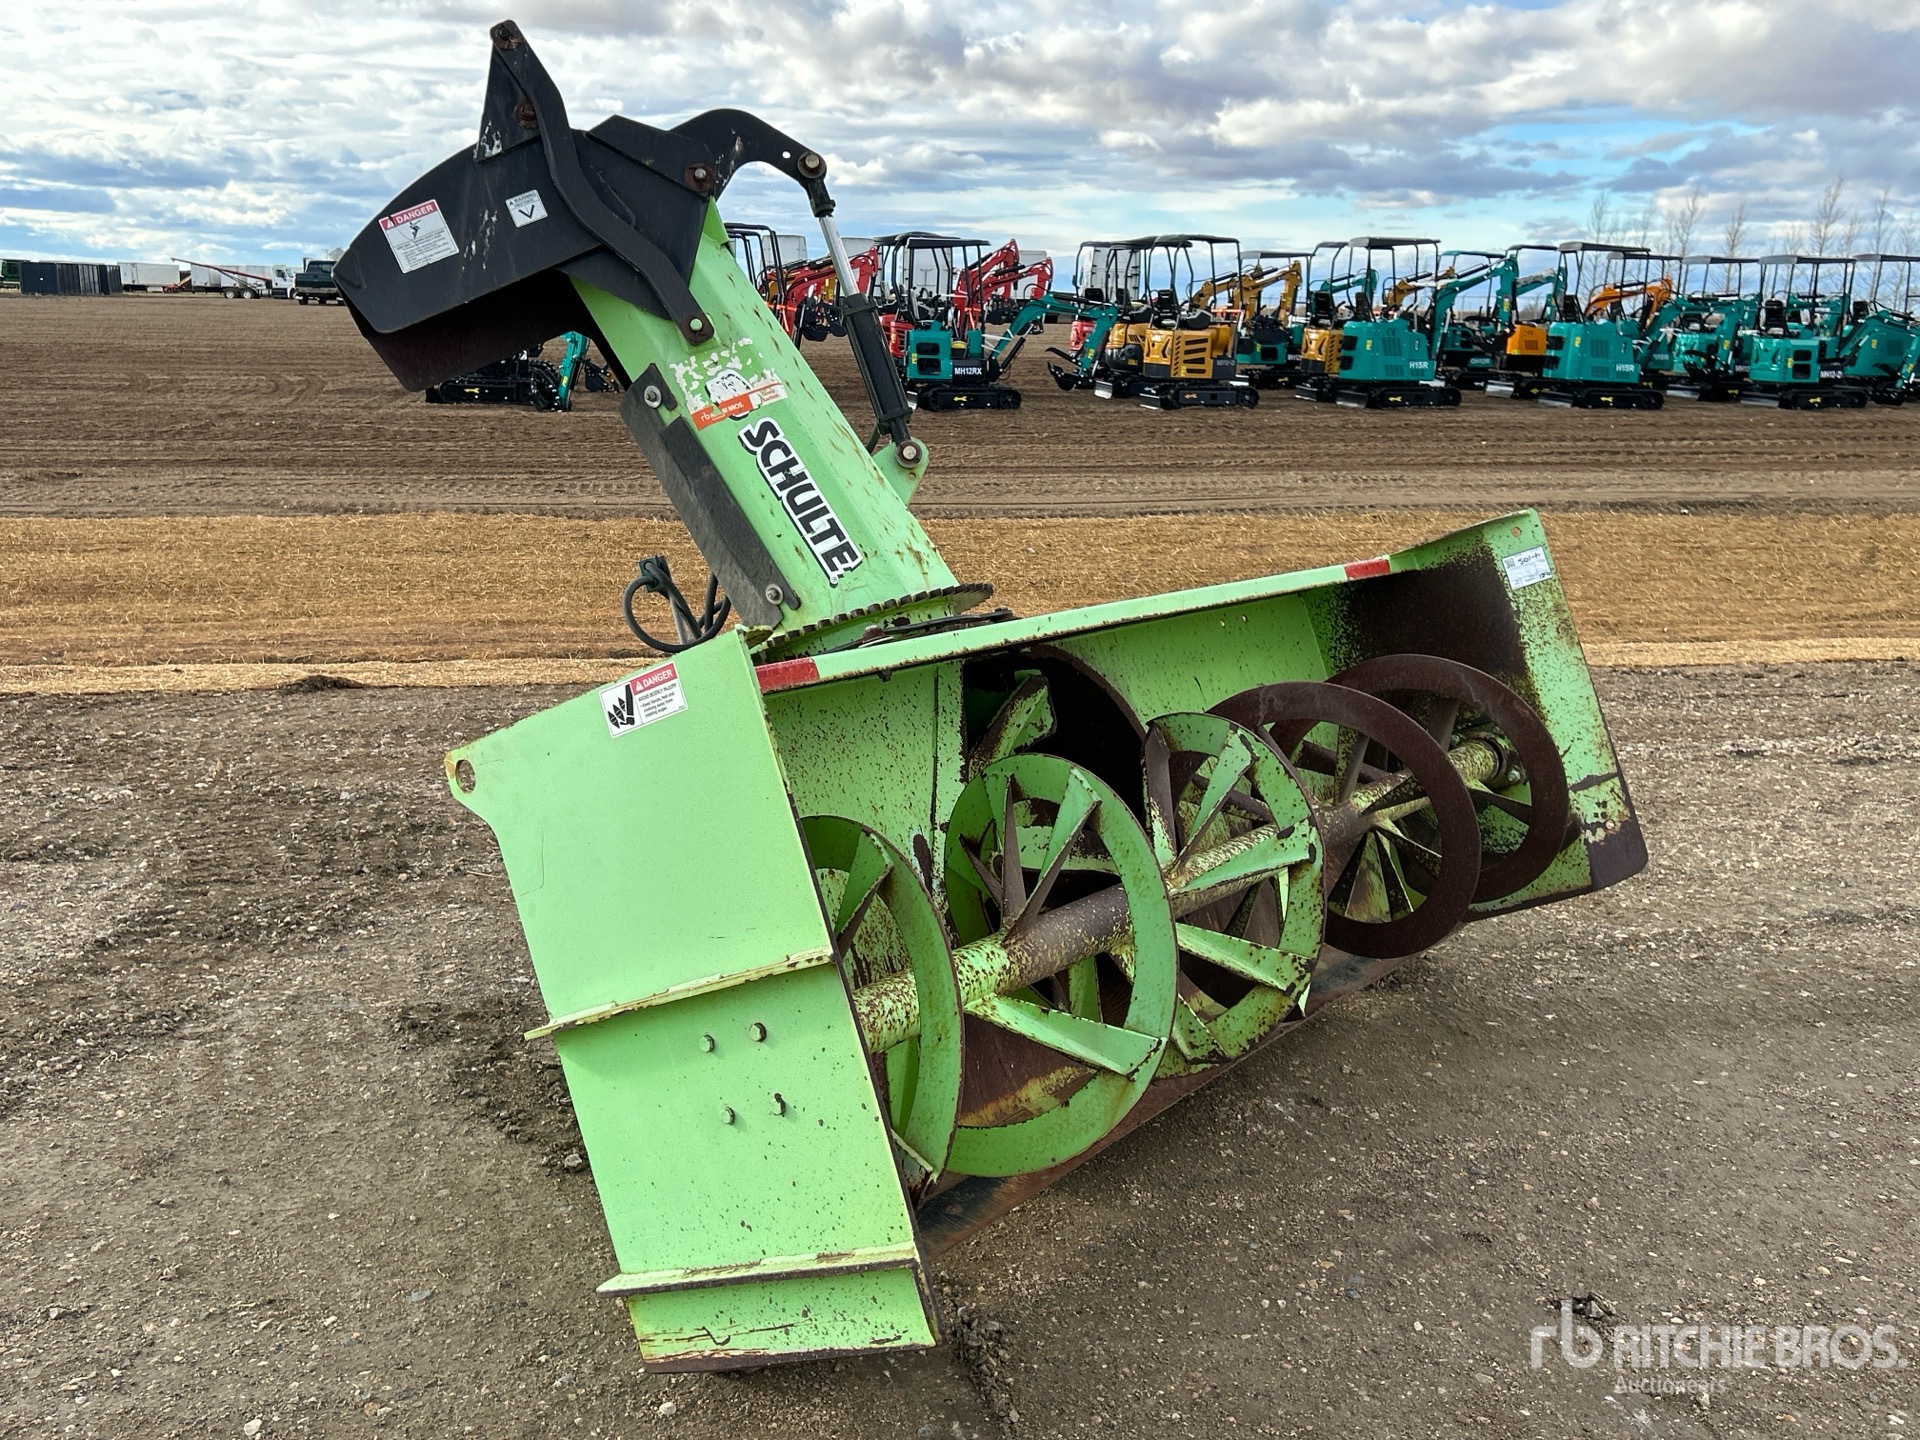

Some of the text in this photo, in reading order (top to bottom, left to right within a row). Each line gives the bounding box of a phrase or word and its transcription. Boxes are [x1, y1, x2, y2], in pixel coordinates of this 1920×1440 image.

[395, 203, 434, 225] DANGER
[954, 367, 982, 375] MH12RX
[742, 420, 860, 573] SCHULTE
[642, 669, 673, 688] DANGER
